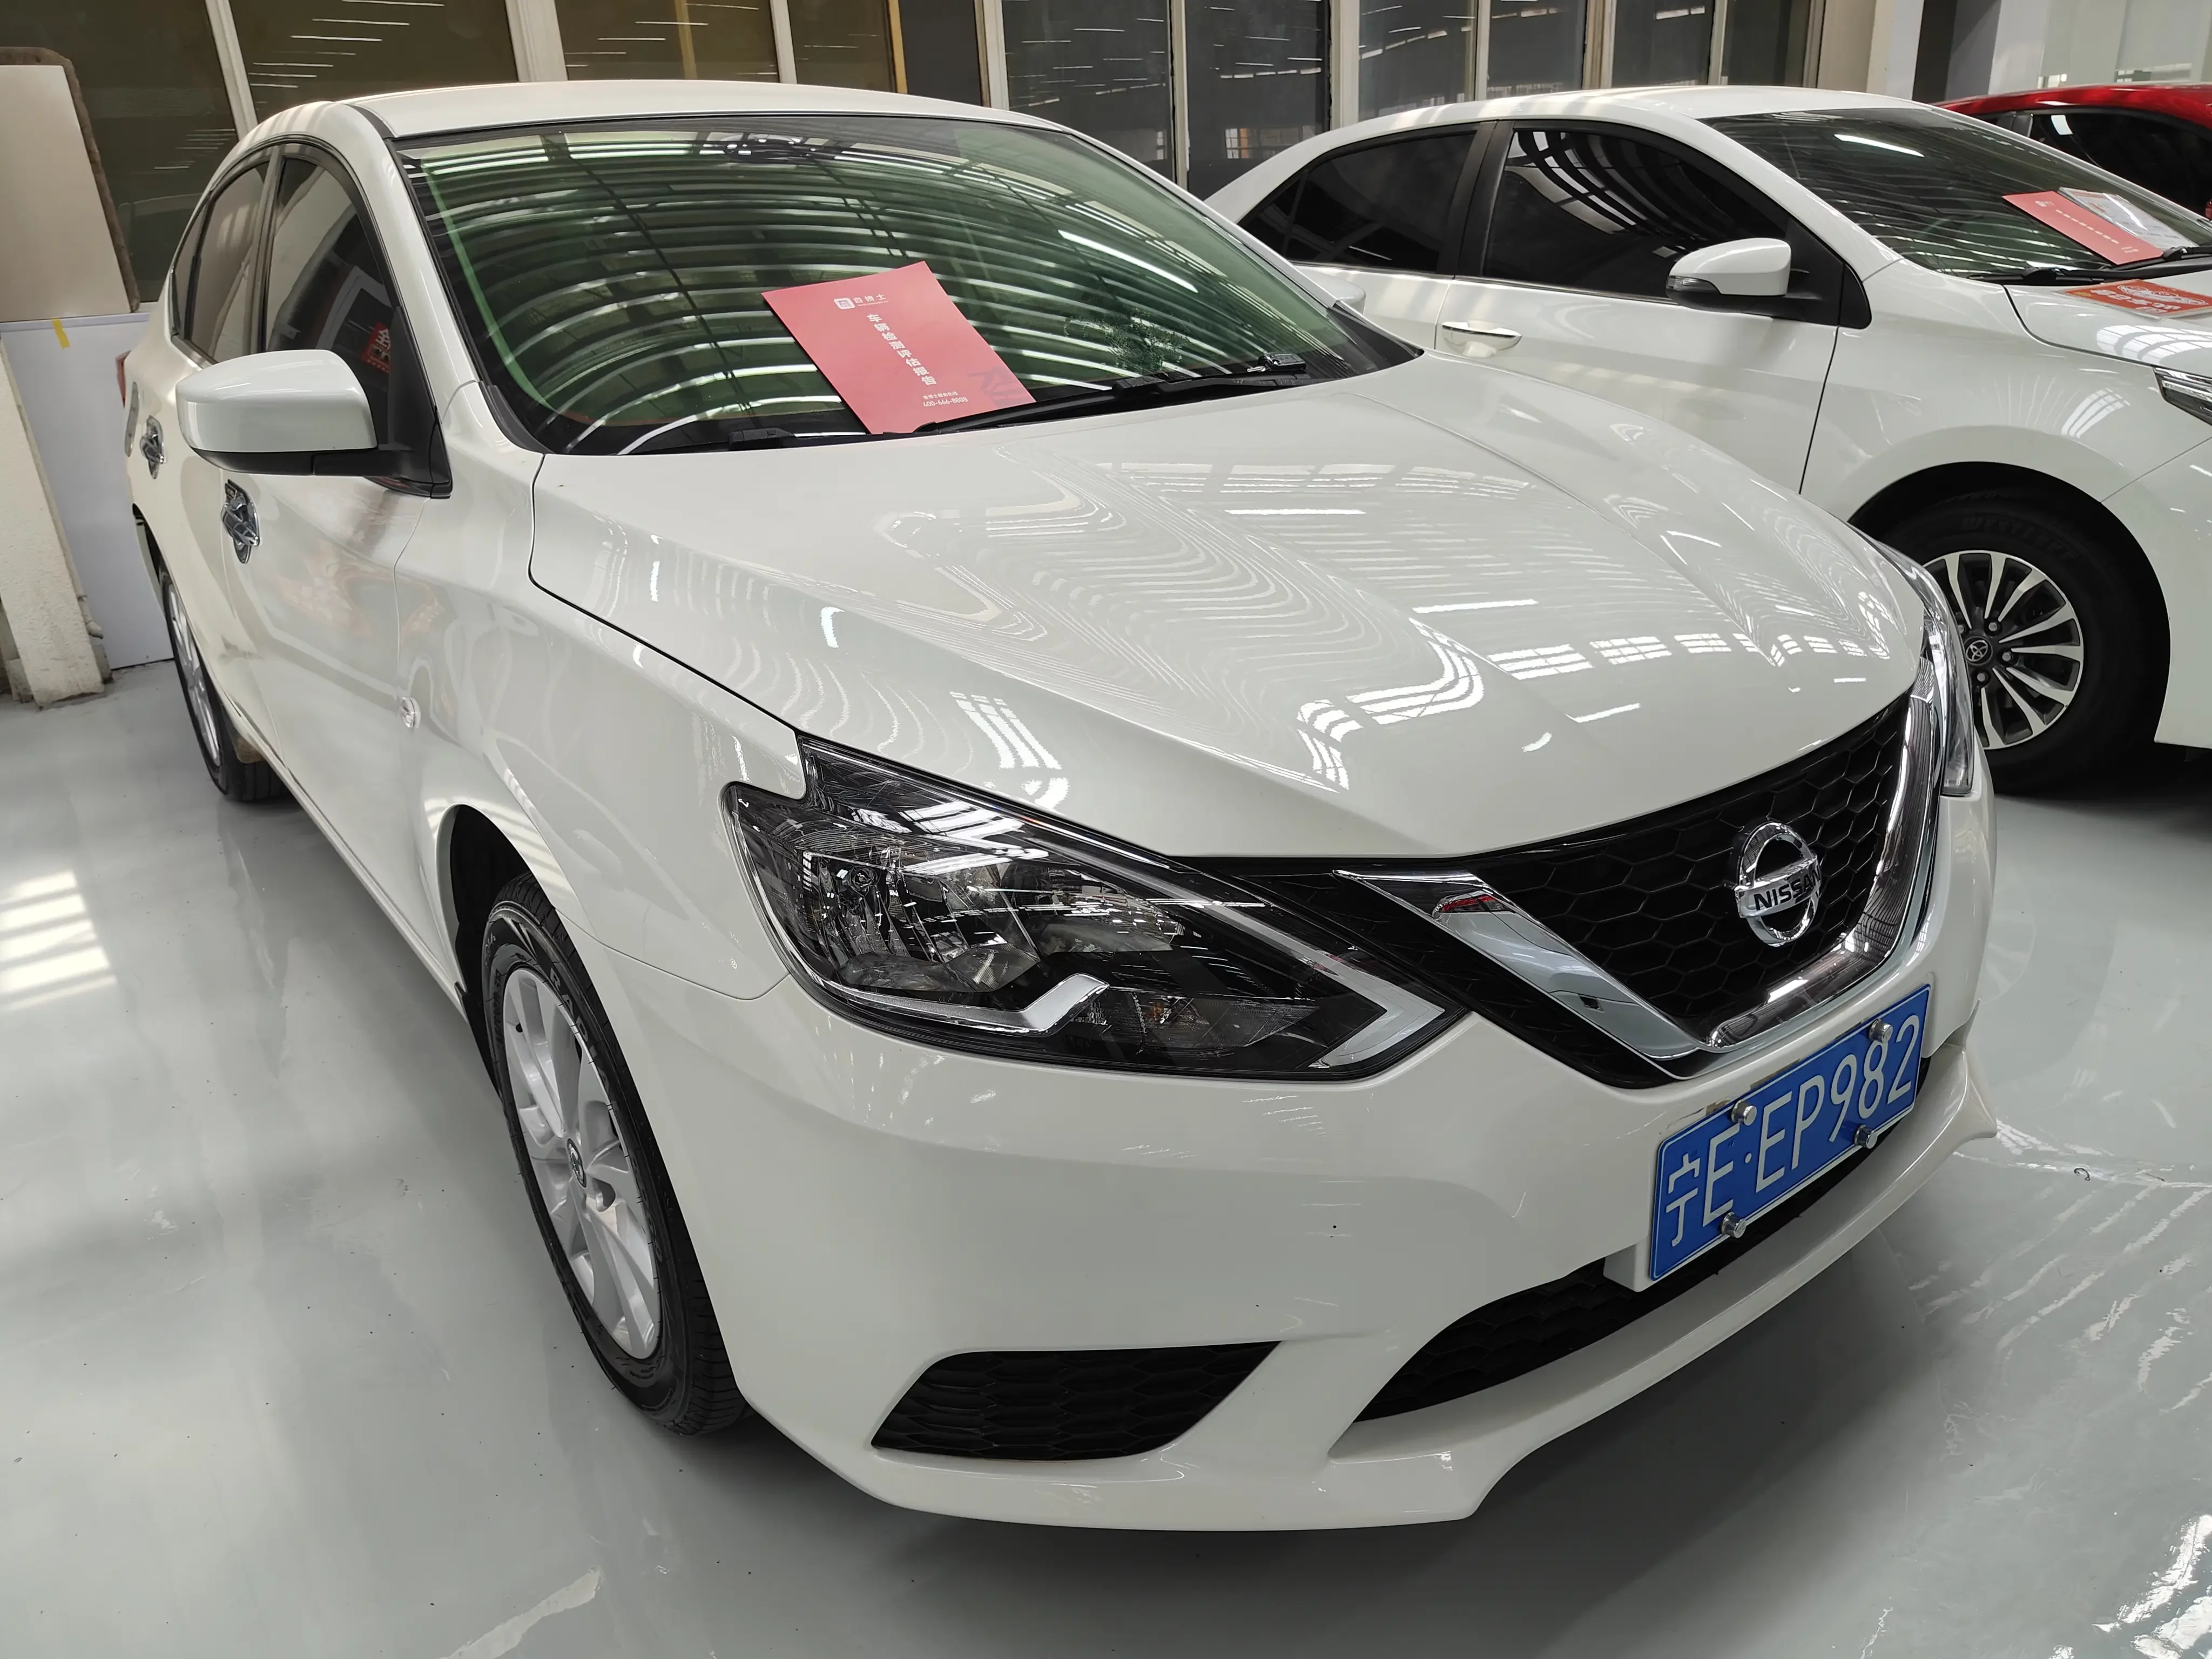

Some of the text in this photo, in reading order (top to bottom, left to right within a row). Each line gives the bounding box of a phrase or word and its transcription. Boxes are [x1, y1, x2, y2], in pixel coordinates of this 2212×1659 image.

[866, 314, 937, 386] 车辆检测评估报告
[1753, 865, 1821, 912] NISSAN
